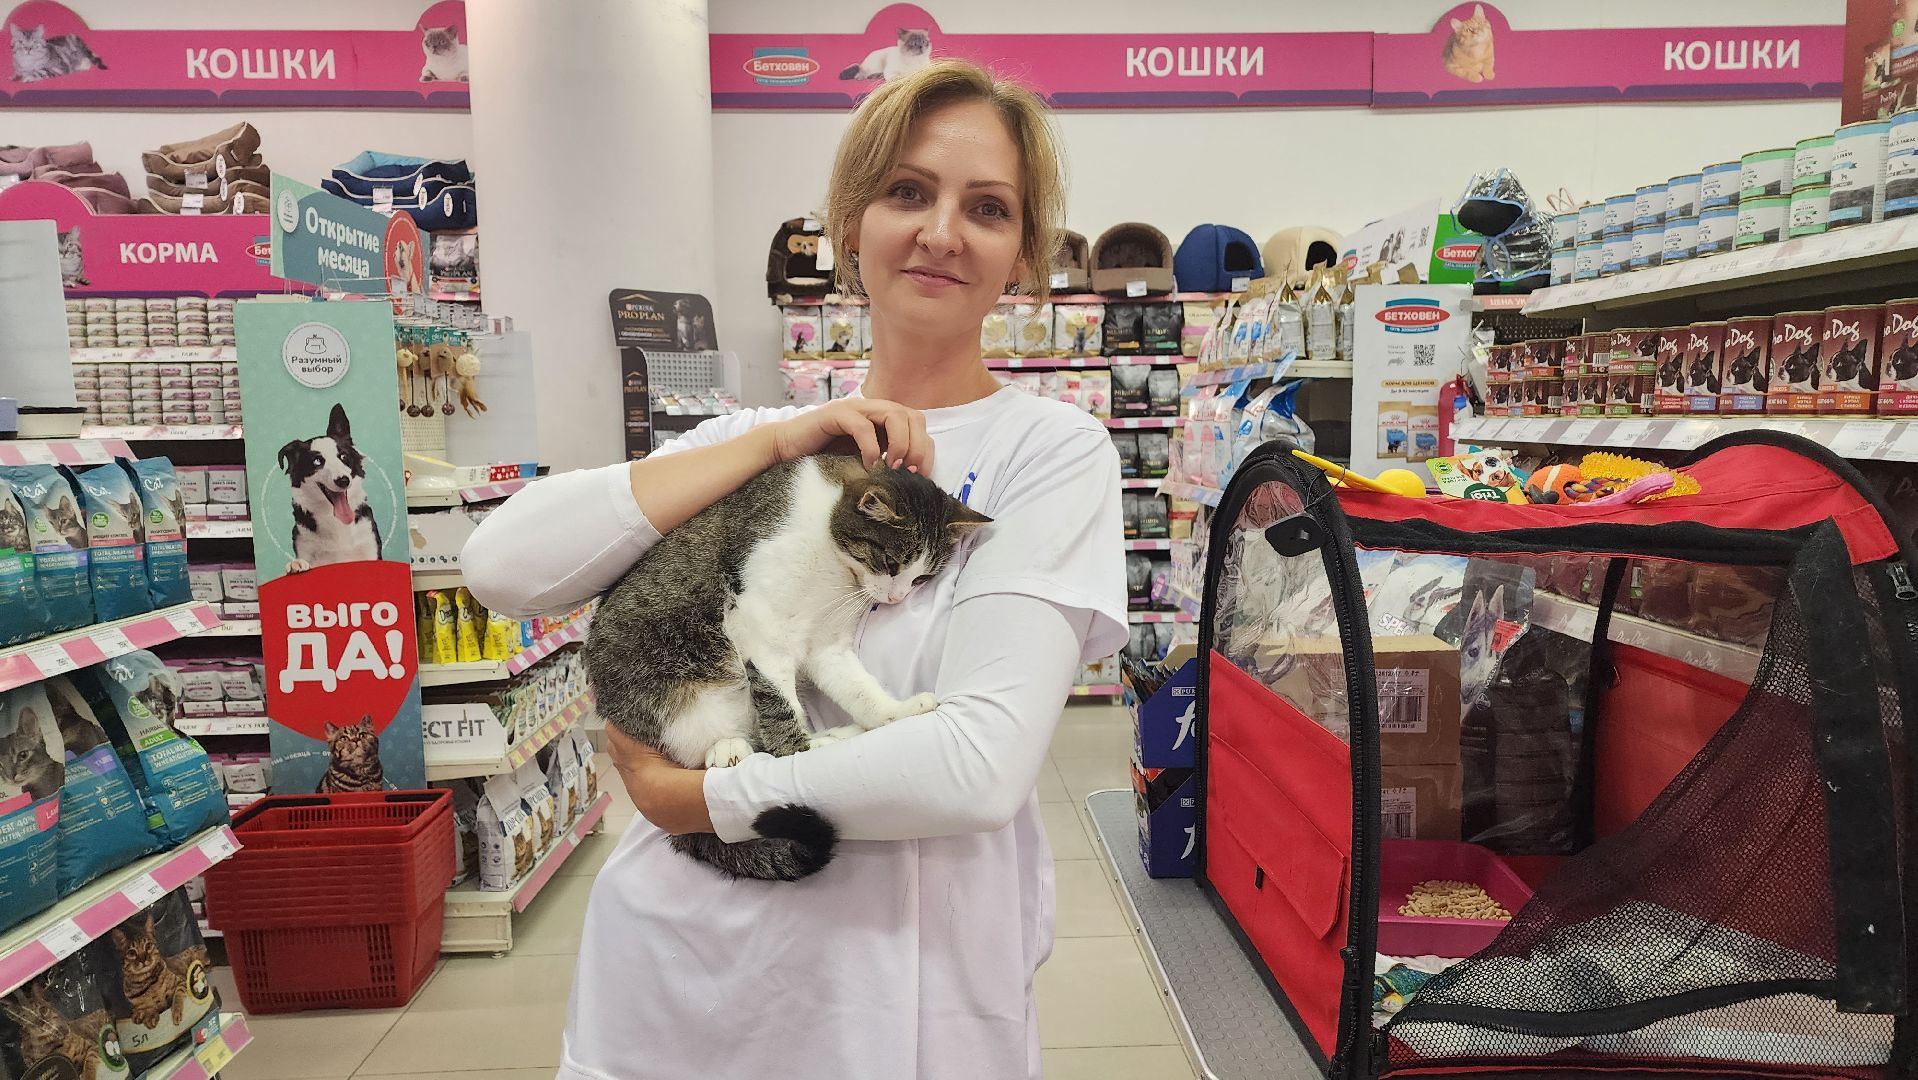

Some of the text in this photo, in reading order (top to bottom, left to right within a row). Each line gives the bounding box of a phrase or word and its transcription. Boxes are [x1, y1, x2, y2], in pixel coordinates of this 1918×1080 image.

[186, 48, 336, 80] КОШКИ
[1126, 46, 1264, 77] КОШКИ
[1664, 39, 1800, 71] КОШКИ
[754, 61, 810, 72] Бетховен
[305, 206, 380, 253] Открытие
[119, 242, 219, 264] КОРМА
[318, 246, 370, 279] месяца
[617, 310, 665, 321] PRO PLAN
[1385, 311, 1440, 321] БЕТХОВЕН
[1731, 329, 1755, 350] Dog
[1785, 324, 1813, 345] Dog
[1832, 319, 1860, 341] Dog
[1617, 333, 1631, 347] Dog
[1660, 337, 1678, 355] Dog
[1690, 334, 1709, 352] Dog
[291, 354, 342, 364] Разумный
[301, 364, 334, 374] выбор
[279, 630, 405, 694] ДА!
[458, 720, 485, 738] FIT
[145, 735, 164, 745] ADULT
